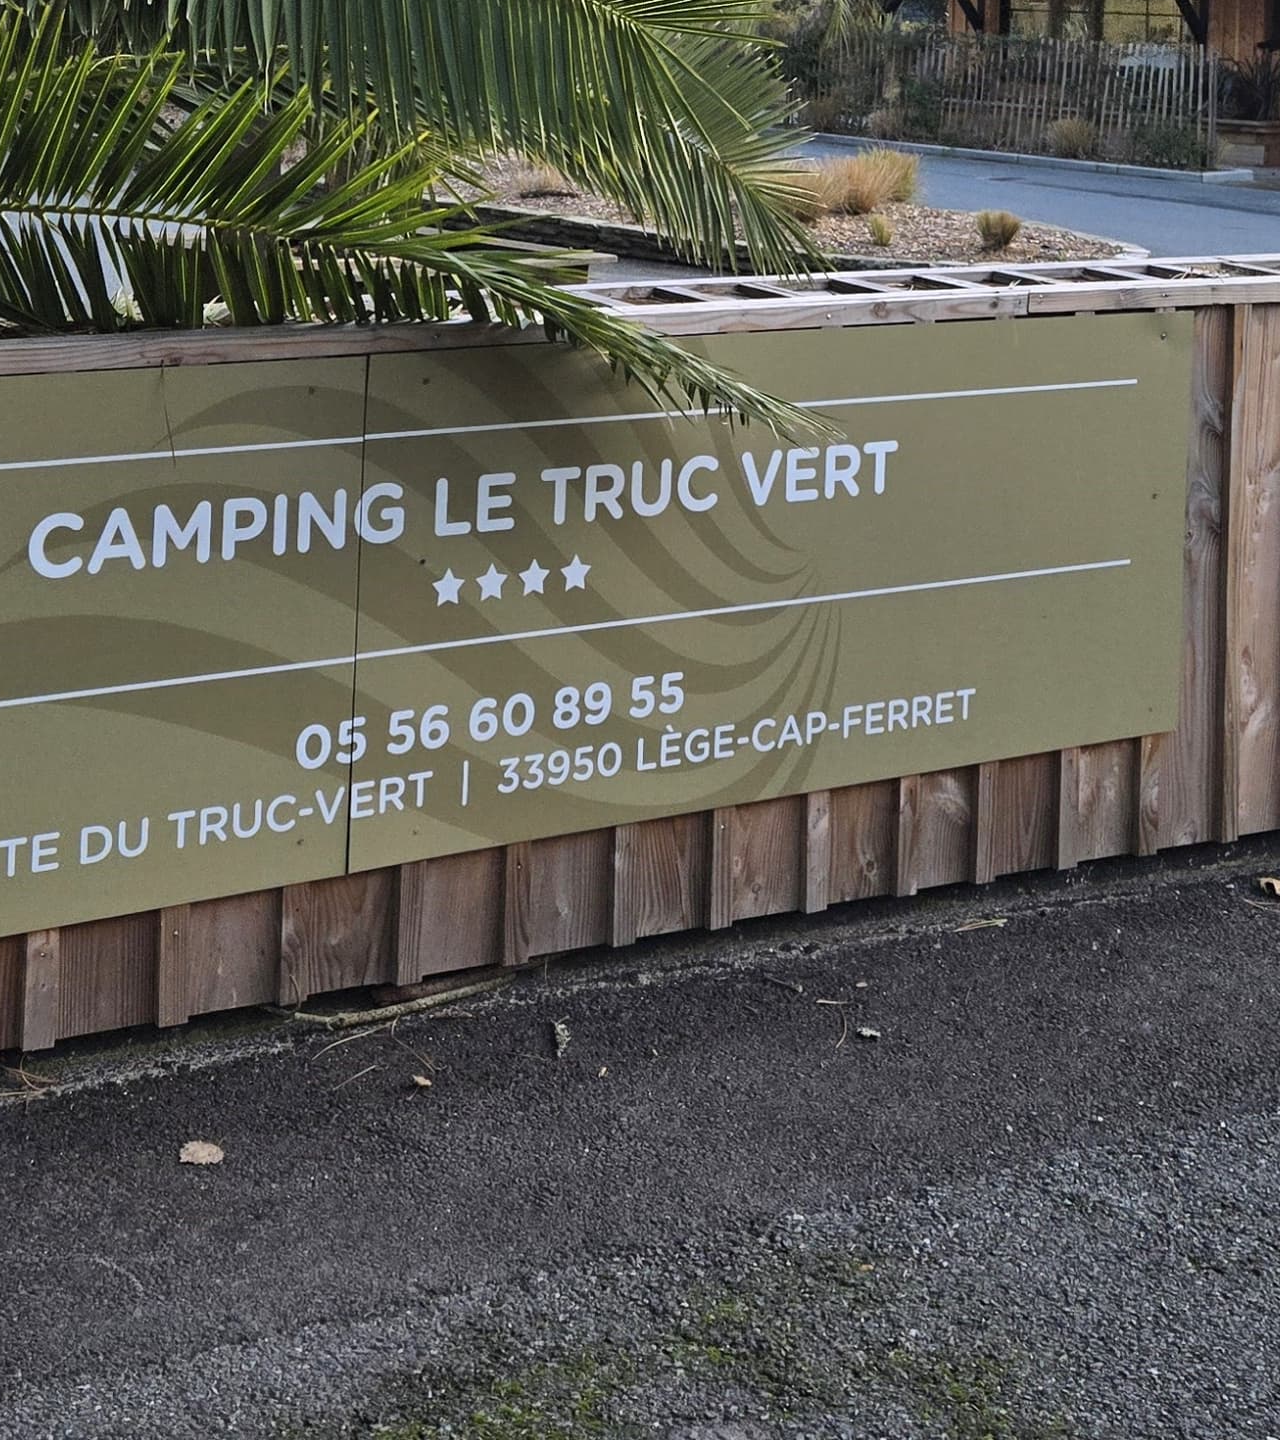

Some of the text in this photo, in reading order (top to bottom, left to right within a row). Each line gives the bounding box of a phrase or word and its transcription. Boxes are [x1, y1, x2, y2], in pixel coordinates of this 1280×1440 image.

[28, 440, 900, 579] CAMPING LE TRUC VERT
[79, 816, 150, 865] DU
[167, 770, 434, 849] TRUC-VERT
[497, 741, 623, 794] 33950
[636, 687, 977, 772] LÈGE-CAP-FERRET
[295, 671, 685, 770] 05 56 60 89 55
